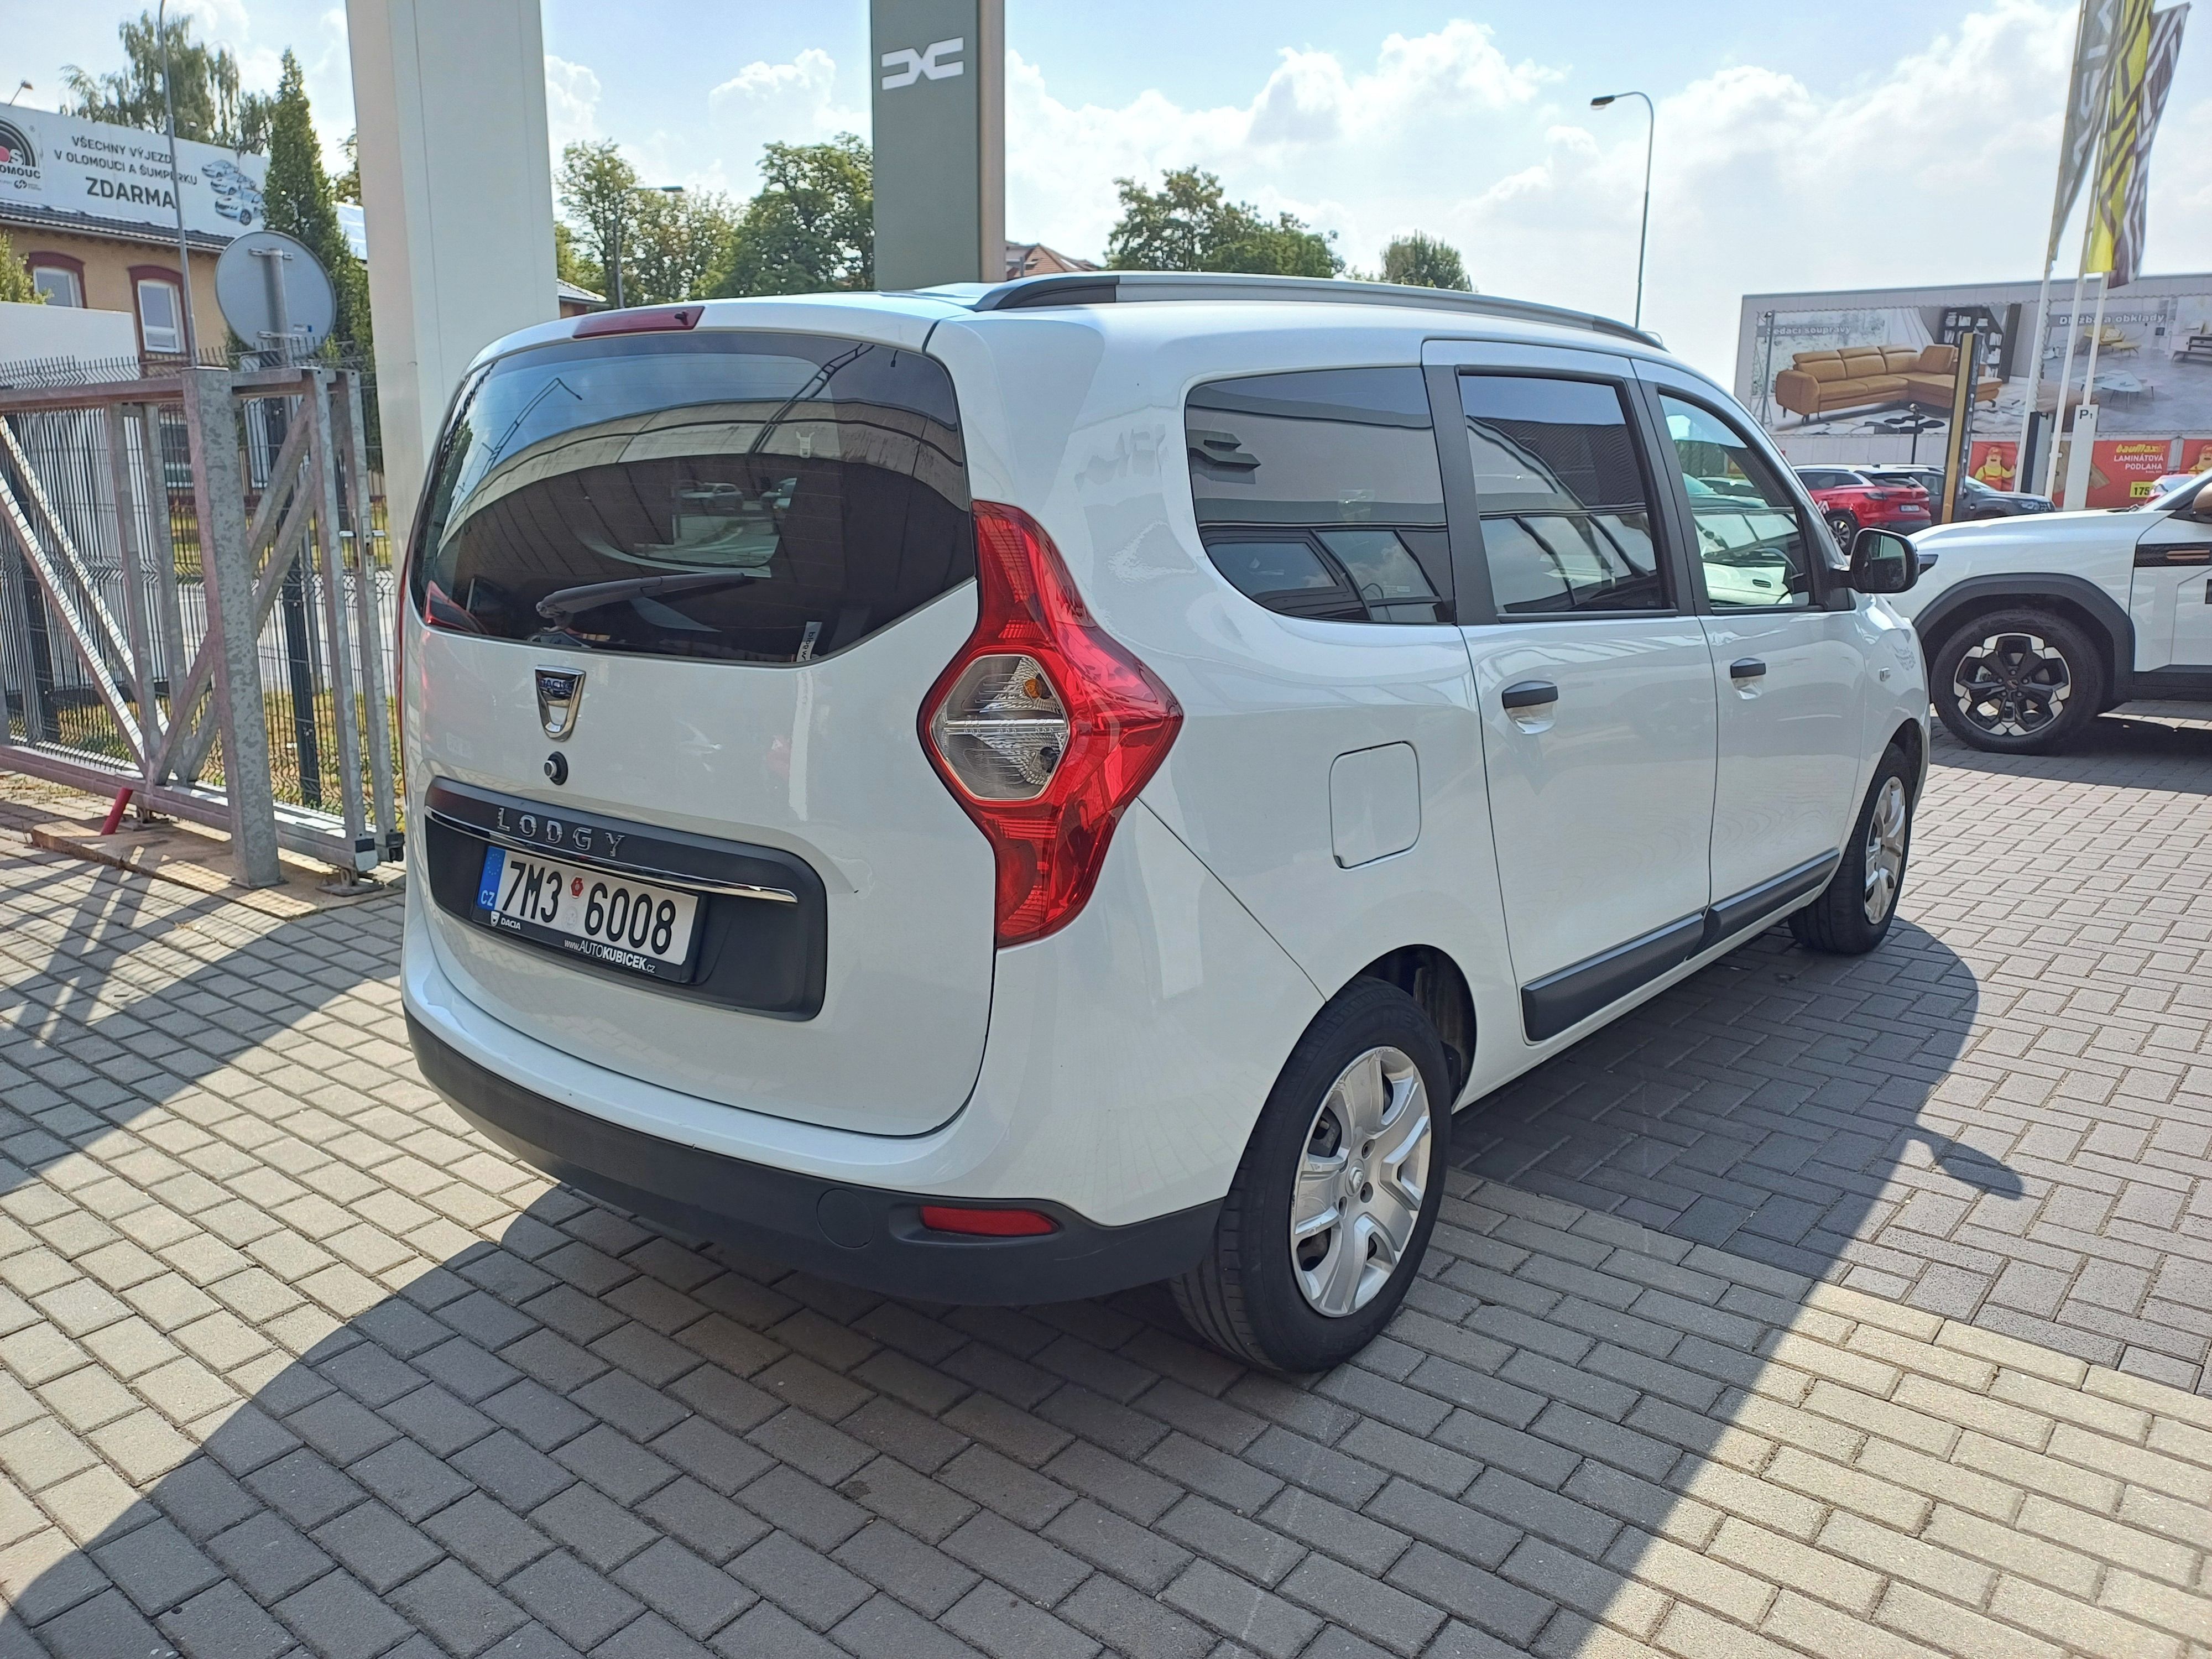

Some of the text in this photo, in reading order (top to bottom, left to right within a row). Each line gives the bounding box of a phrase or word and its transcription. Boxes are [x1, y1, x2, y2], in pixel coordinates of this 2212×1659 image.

[72, 135, 174, 164] VŠECHNY VÝJEZD
[54, 149, 62, 160] V
[66, 152, 125, 171] OLOMOUCI
[129, 164, 137, 174] A
[85, 176, 176, 209] ZDARMA
[2115, 314, 2164, 322] obklady
[2114, 453, 2163, 462] LAMINÁTOVÁ
[2134, 487, 2150, 495] 175
[497, 807, 625, 857] LODGY
[481, 889, 495, 906] CZ
[502, 860, 676, 955] 7M3 6008
[500, 917, 521, 930] DACIA
